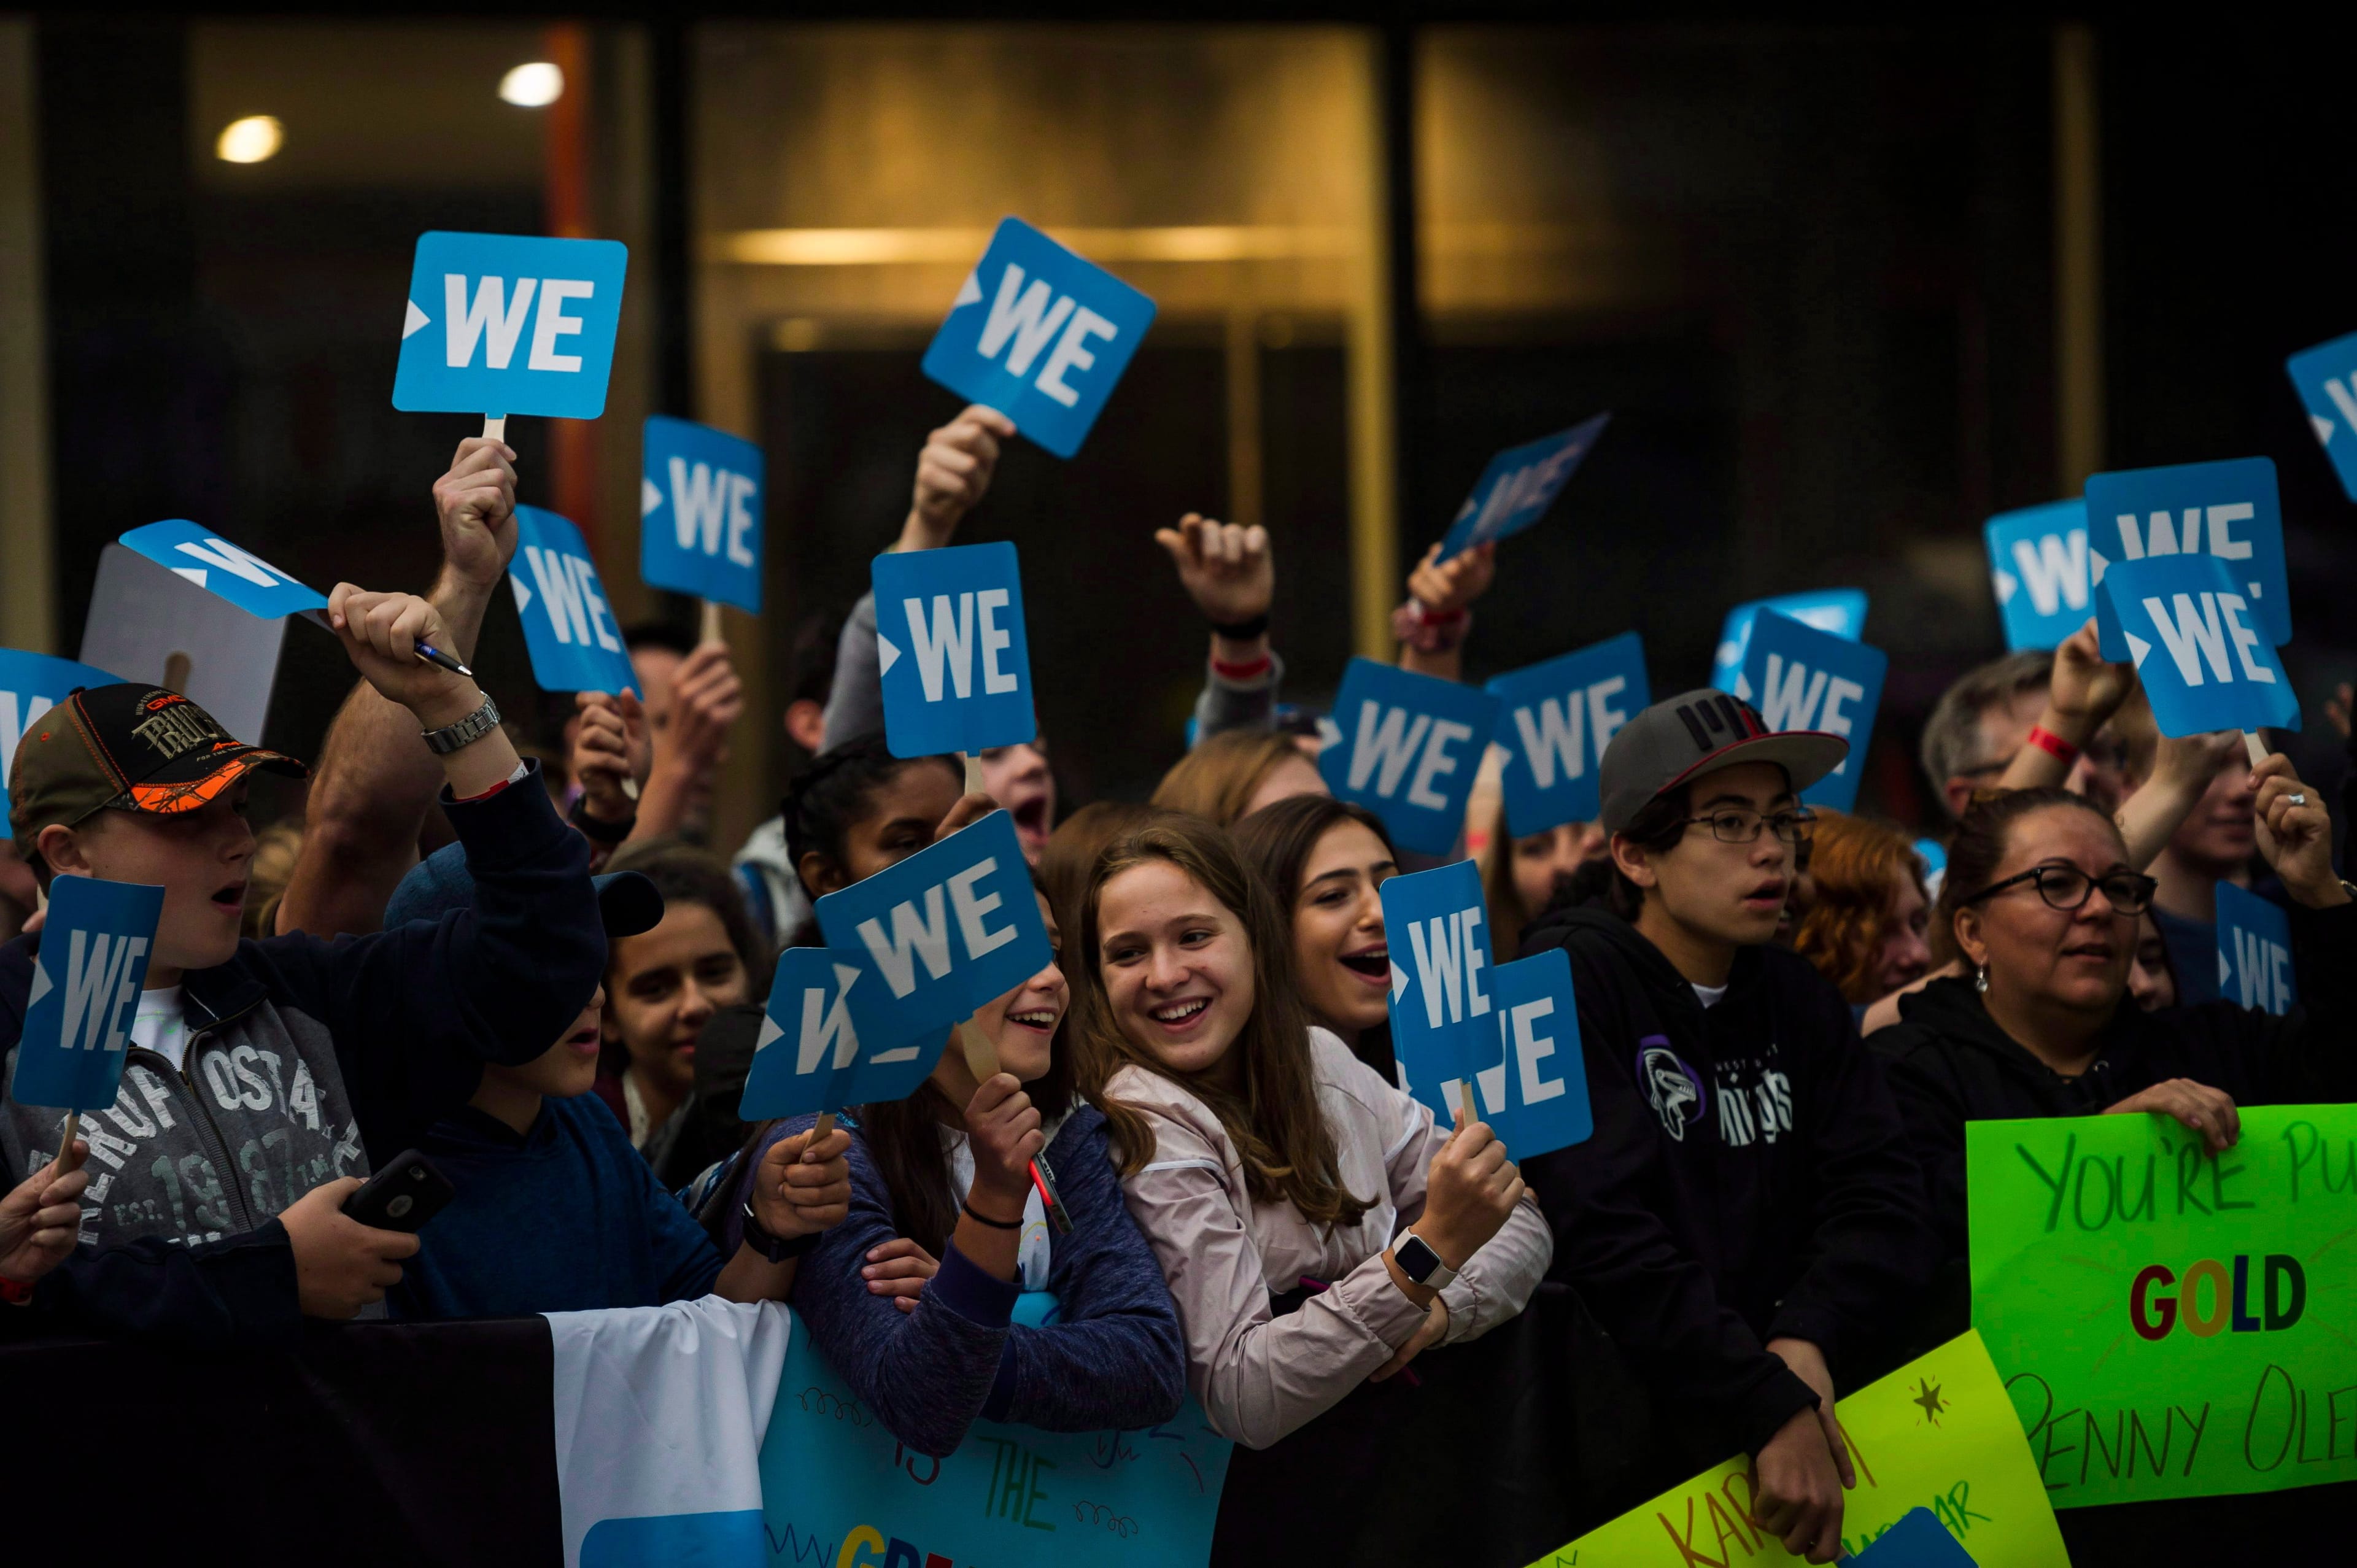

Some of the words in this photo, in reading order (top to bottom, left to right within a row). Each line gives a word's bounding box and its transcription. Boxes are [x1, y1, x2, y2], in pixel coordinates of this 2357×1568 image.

[444, 274, 594, 373] WE
[977, 263, 1118, 407] WE
[668, 457, 756, 568] WE
[1471, 443, 1582, 536] WE
[174, 538, 301, 587] W
[525, 546, 620, 653] WE
[2011, 530, 2088, 616] W
[904, 589, 1018, 702] WE
[2142, 592, 2276, 686] WE
[1347, 700, 1472, 811] WE
[1514, 676, 1626, 788] WE
[1760, 652, 1864, 775] WE
[856, 856, 1018, 1000] WE
[1407, 906, 1491, 1029] WE
[2233, 926, 2293, 1016] WE
[60, 929, 149, 1051] WE
[2016, 1132, 2256, 1233] YOU'RE
[2129, 1254, 2307, 1342] GOLD
[2005, 1372, 2211, 1491] PENNY
[2244, 1363, 2357, 1473] OLE
[976, 1435, 1056, 1532] THE
